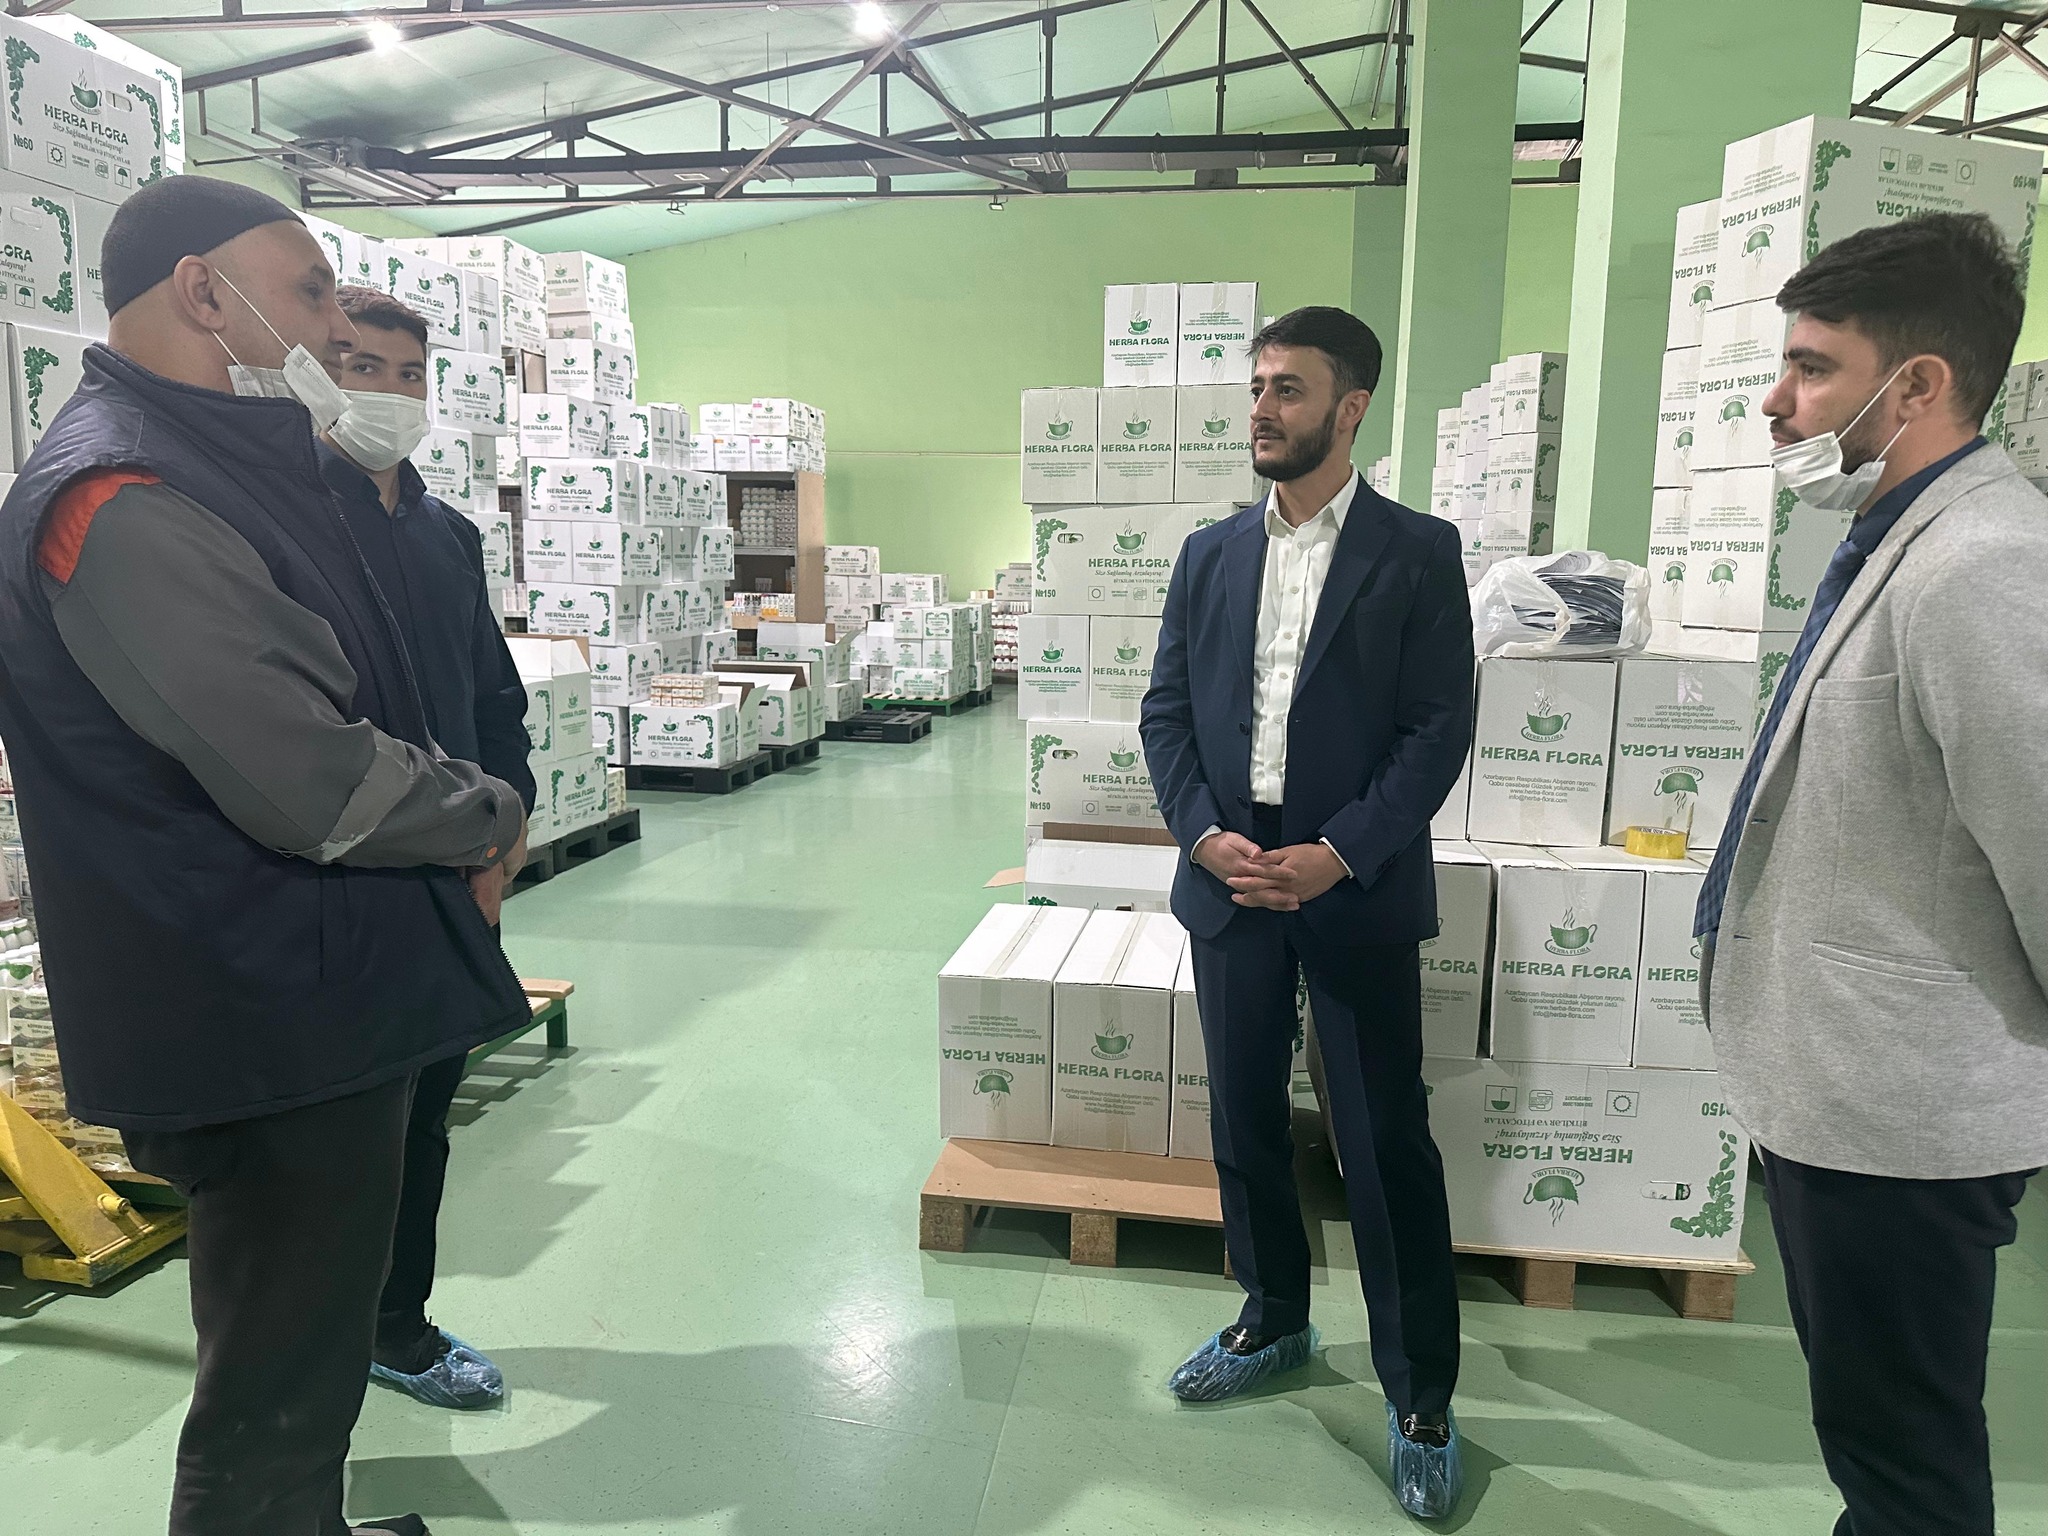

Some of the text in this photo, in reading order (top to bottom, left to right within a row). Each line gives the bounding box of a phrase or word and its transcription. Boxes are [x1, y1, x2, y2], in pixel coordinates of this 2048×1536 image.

[44, 104, 88, 130] HERBA
[91, 121, 129, 145] FLORA
[1721, 195, 1801, 229] HERBA FLORA
[1, 244, 33, 262] ORA
[1675, 265, 1703, 280] FLORA
[1109, 337, 1170, 346] HERBA FLORA
[1700, 378, 1734, 393] FLORA
[1737, 372, 1776, 388] HERBA
[1660, 411, 1687, 422] FLORA
[1025, 444, 1094, 453] HERBA FLORA
[1101, 443, 1172, 453] HERBA FLORA
[1180, 442, 1252, 451] HERBA FLORA
[1650, 546, 1674, 555] FLORA
[1690, 540, 1765, 553] HERBA FLORA
[1088, 558, 1170, 568] HERBA FLORA
[1035, 589, 1056, 598] №150
[1093, 667, 1152, 677] HERBA FLO
[1481, 746, 1604, 766] HERBA FLORA
[1620, 744, 1744, 760] HERBA FLORA
[1083, 774, 1152, 785] HERBA FLO
[1030, 801, 1051, 810] №150
[1419, 958, 1478, 974] FLORA
[1502, 960, 1633, 981] HERBA FLORA
[1648, 968, 1698, 982] HERB
[942, 1048, 1046, 1065] HERBA FLORA
[1058, 1063, 1165, 1083] HERBA FLORA
[1178, 1074, 1209, 1087] HER
[1701, 1101, 1731, 1116] 150
[1483, 1143, 1633, 1164] HERBA FLORA
